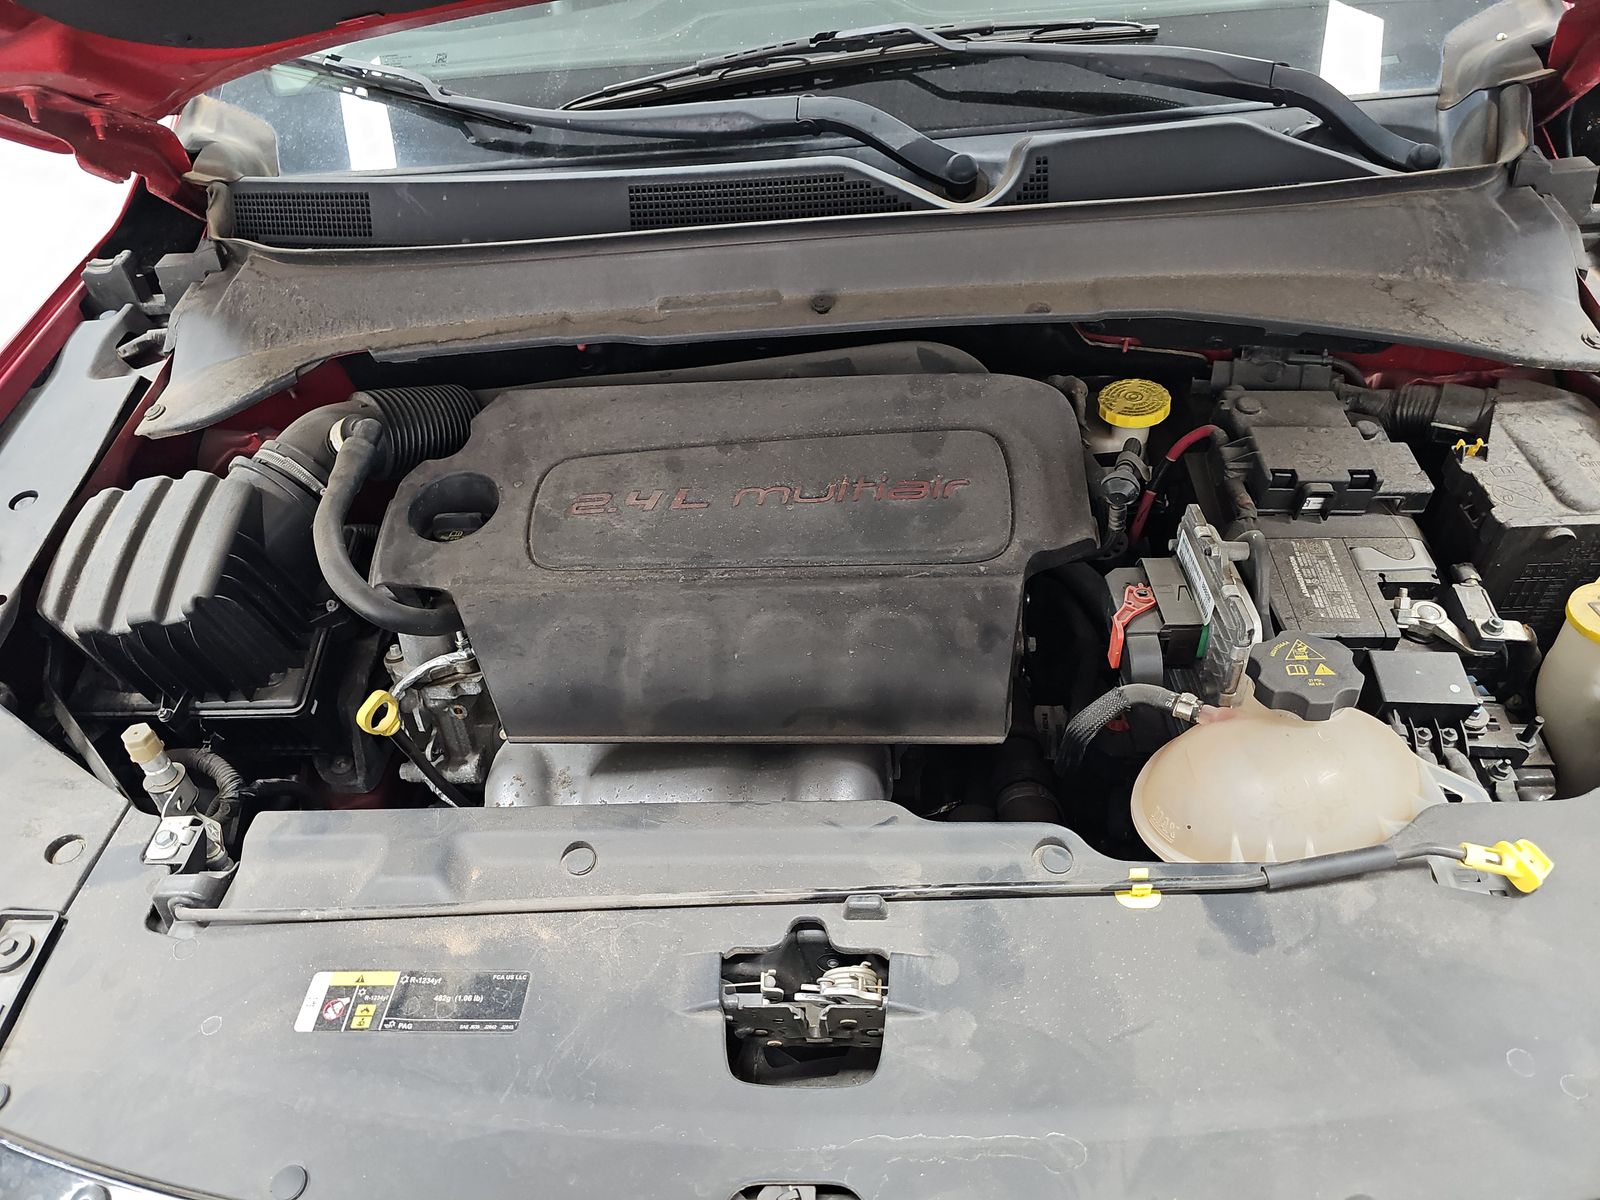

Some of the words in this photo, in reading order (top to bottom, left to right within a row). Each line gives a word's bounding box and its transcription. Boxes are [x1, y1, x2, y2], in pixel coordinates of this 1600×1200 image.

[732, 474, 971, 507] multiair
[410, 976, 442, 986] R-1234yf
[433, 995, 452, 1003] 482g
[454, 995, 473, 1003] (1.06
[473, 995, 484, 1003] lb)
[398, 1022, 413, 1030] PAG
